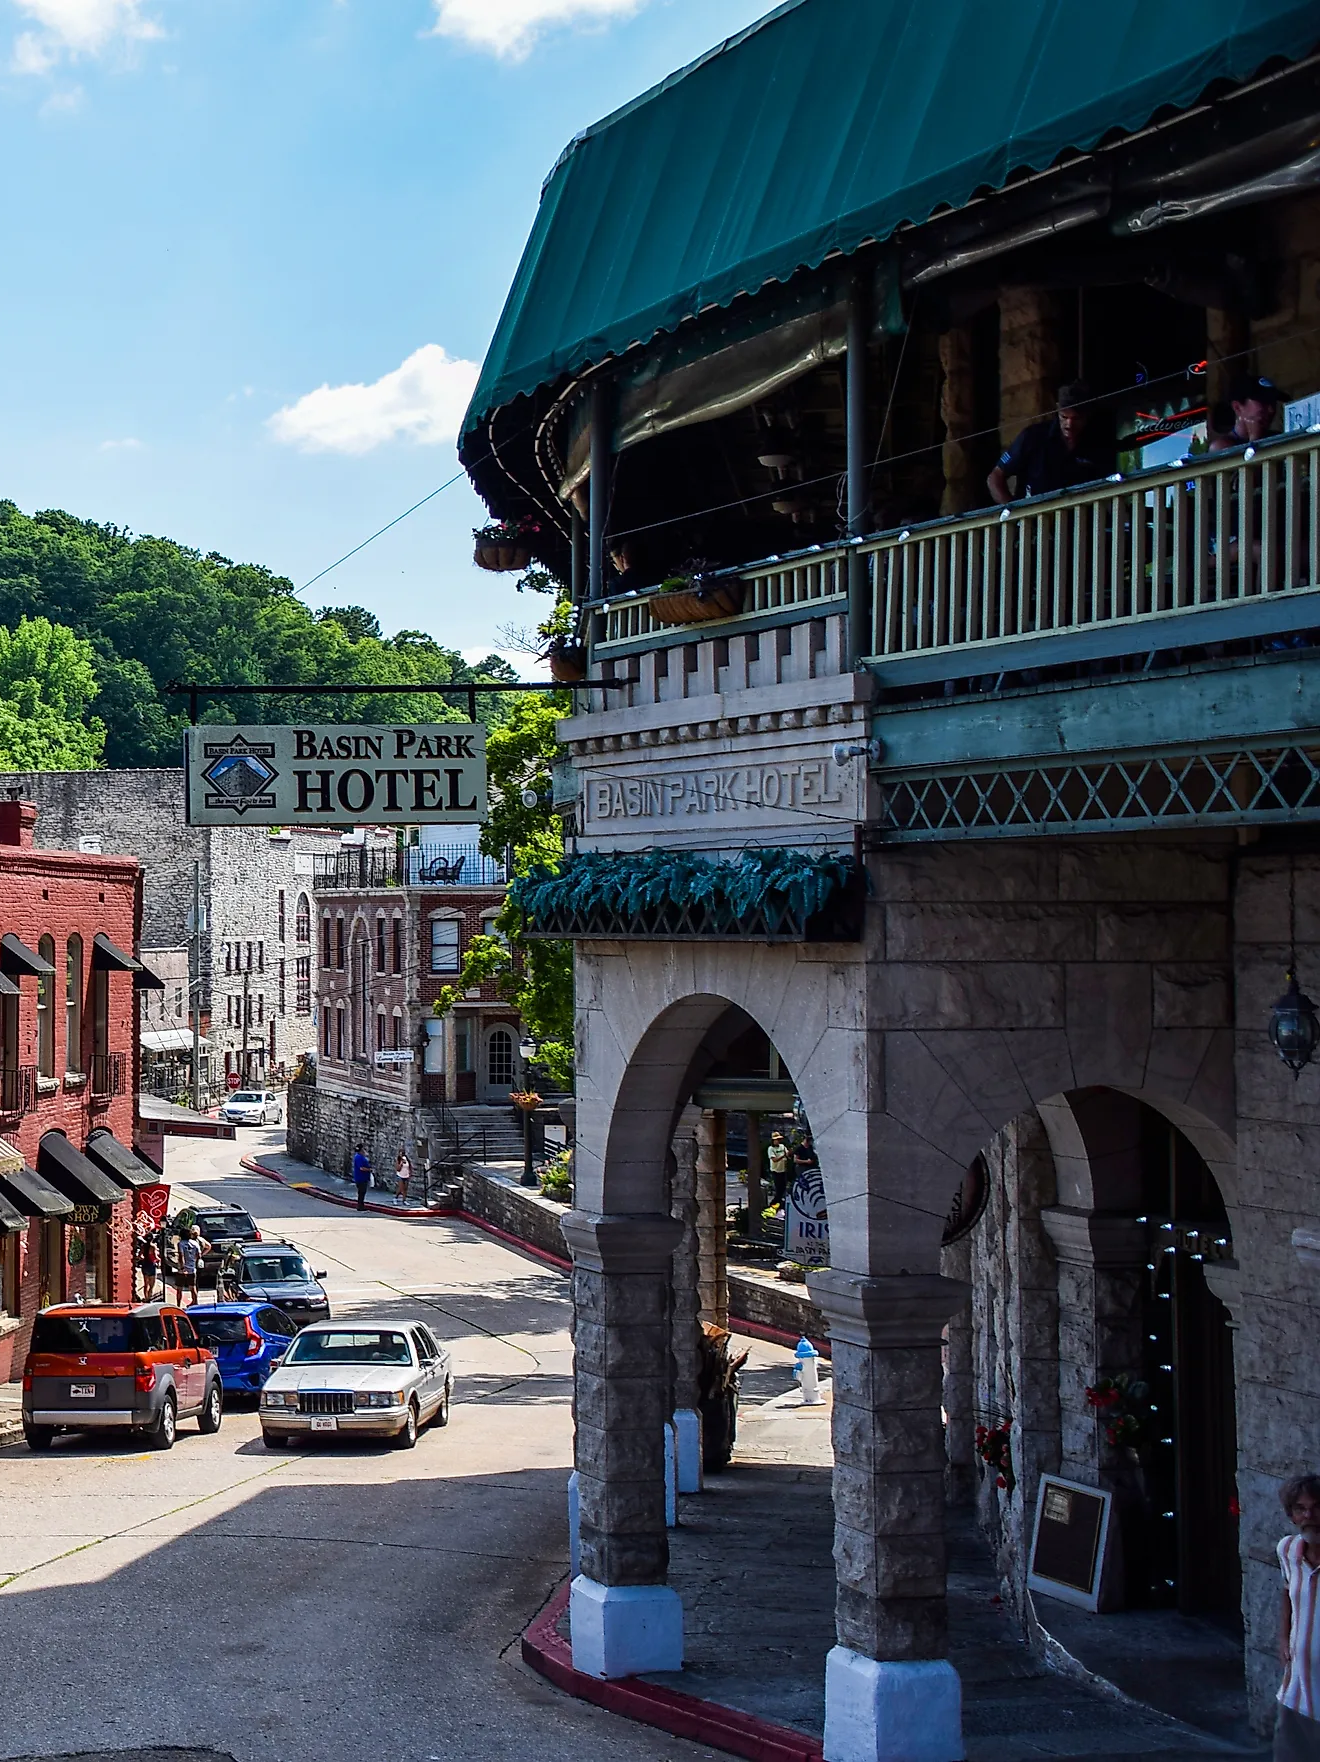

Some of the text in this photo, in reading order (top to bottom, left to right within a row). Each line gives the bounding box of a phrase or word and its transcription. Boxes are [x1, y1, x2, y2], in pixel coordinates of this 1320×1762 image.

[293, 729, 477, 760] BASIN PARK
[293, 769, 477, 812] HOTEL
[597, 764, 842, 818] BASIN PARK HOTEL
[227, 1077, 240, 1085] STOP
[67, 1212, 99, 1222] SHOP
